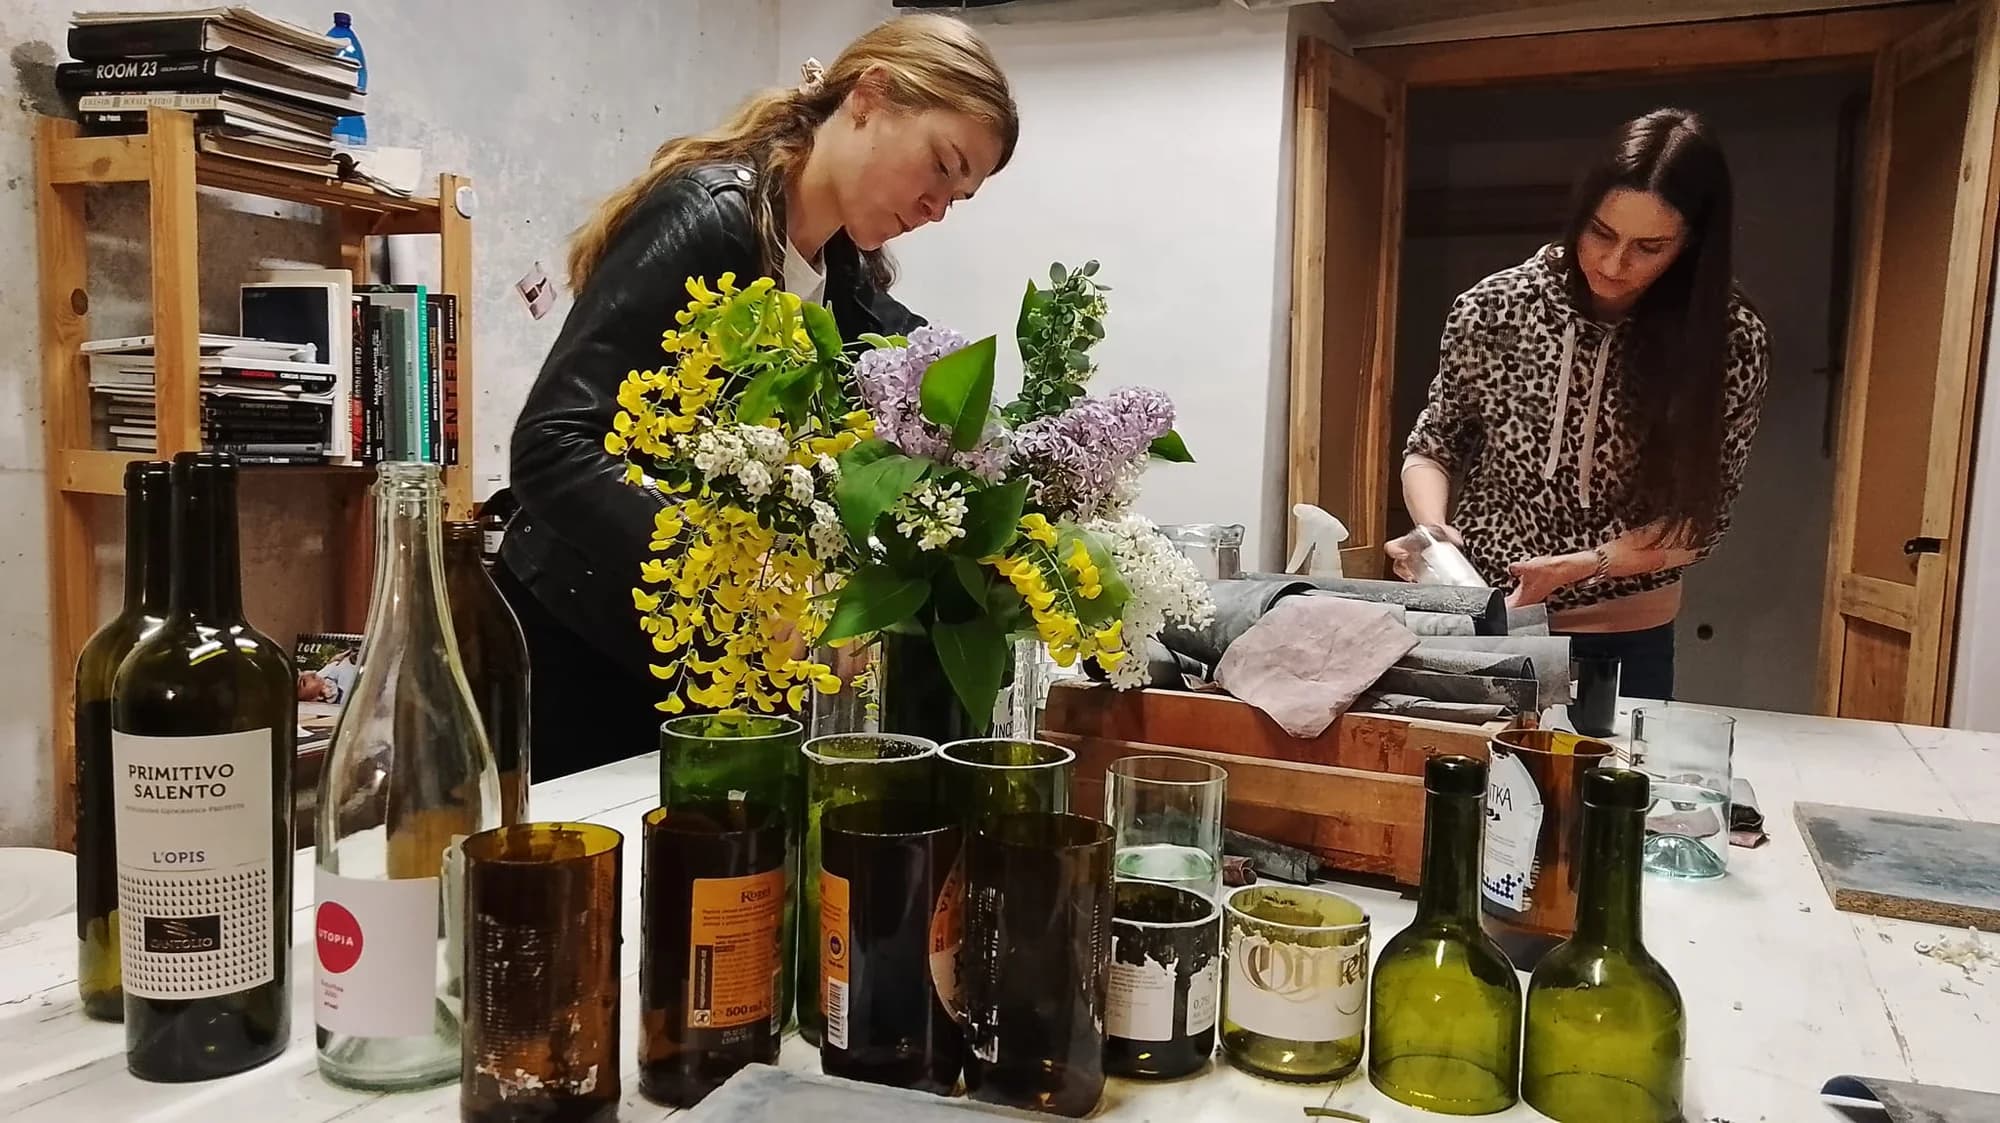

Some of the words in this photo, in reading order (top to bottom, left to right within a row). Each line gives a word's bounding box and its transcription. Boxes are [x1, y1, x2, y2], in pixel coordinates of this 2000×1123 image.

[96, 64, 137, 79] ROOM
[140, 61, 158, 76] 23
[444, 345, 457, 442] ENTER
[128, 763, 234, 781] PRIMITIVO
[133, 783, 226, 799] SALENTO
[151, 850, 206, 864] L'OPIS
[318, 927, 355, 947] UTOPIA
[725, 1004, 748, 1017] 500
